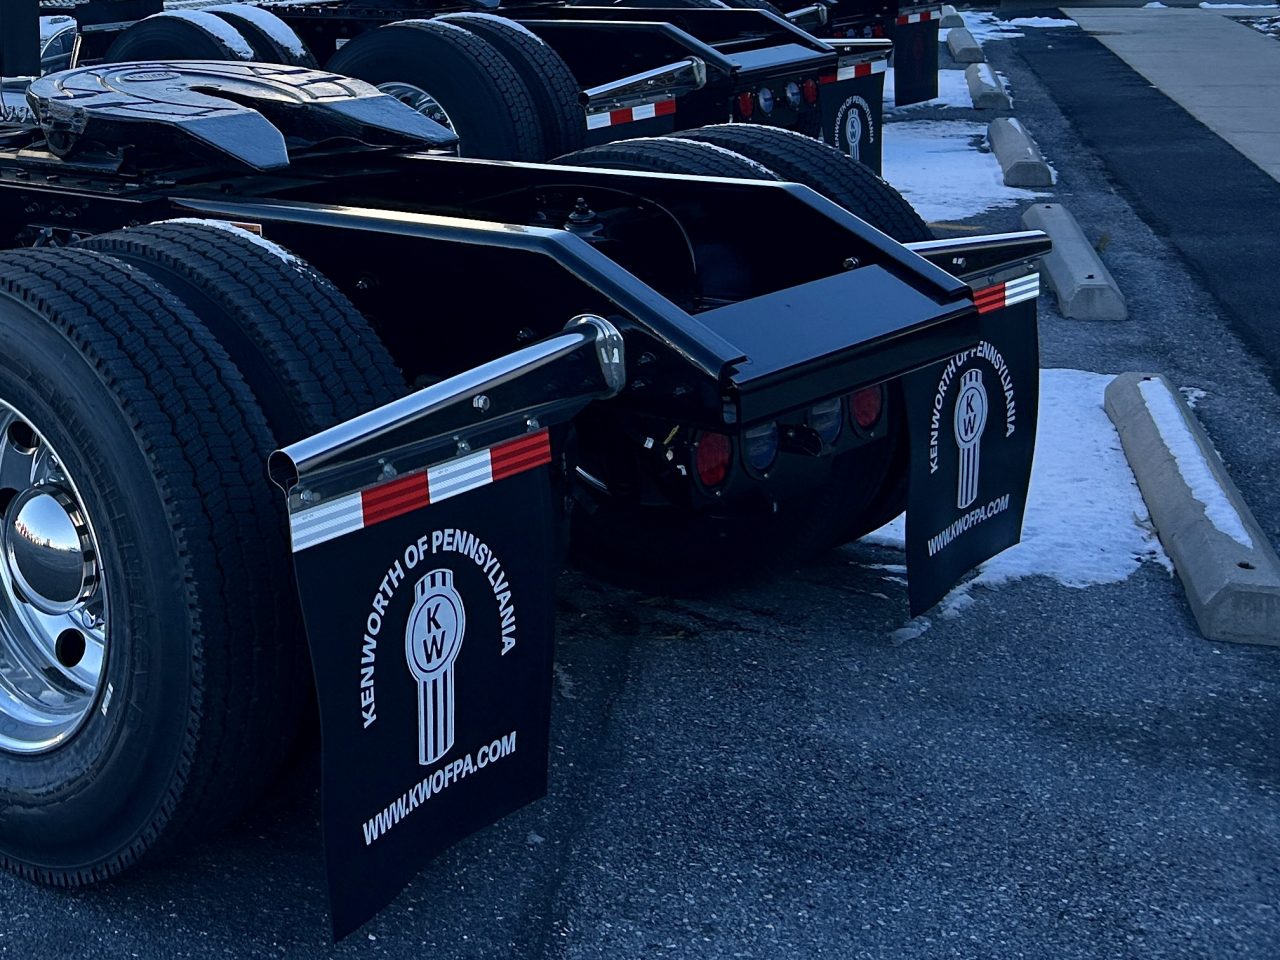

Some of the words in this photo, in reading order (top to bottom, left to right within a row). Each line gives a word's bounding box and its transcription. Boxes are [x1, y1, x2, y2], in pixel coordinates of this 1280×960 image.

[835, 103, 846, 147] ENWORTH
[930, 359, 956, 474] KENWORTH
[928, 494, 1009, 557] WWW.KWOFPA.COM
[360, 561, 405, 728] KENWORTH
[405, 535, 429, 570] OF
[432, 528, 516, 656] PENNSYLVANIA
[426, 602, 442, 633] K
[422, 634, 446, 665] W
[363, 731, 517, 845] WWW.KWOFPA.COM
